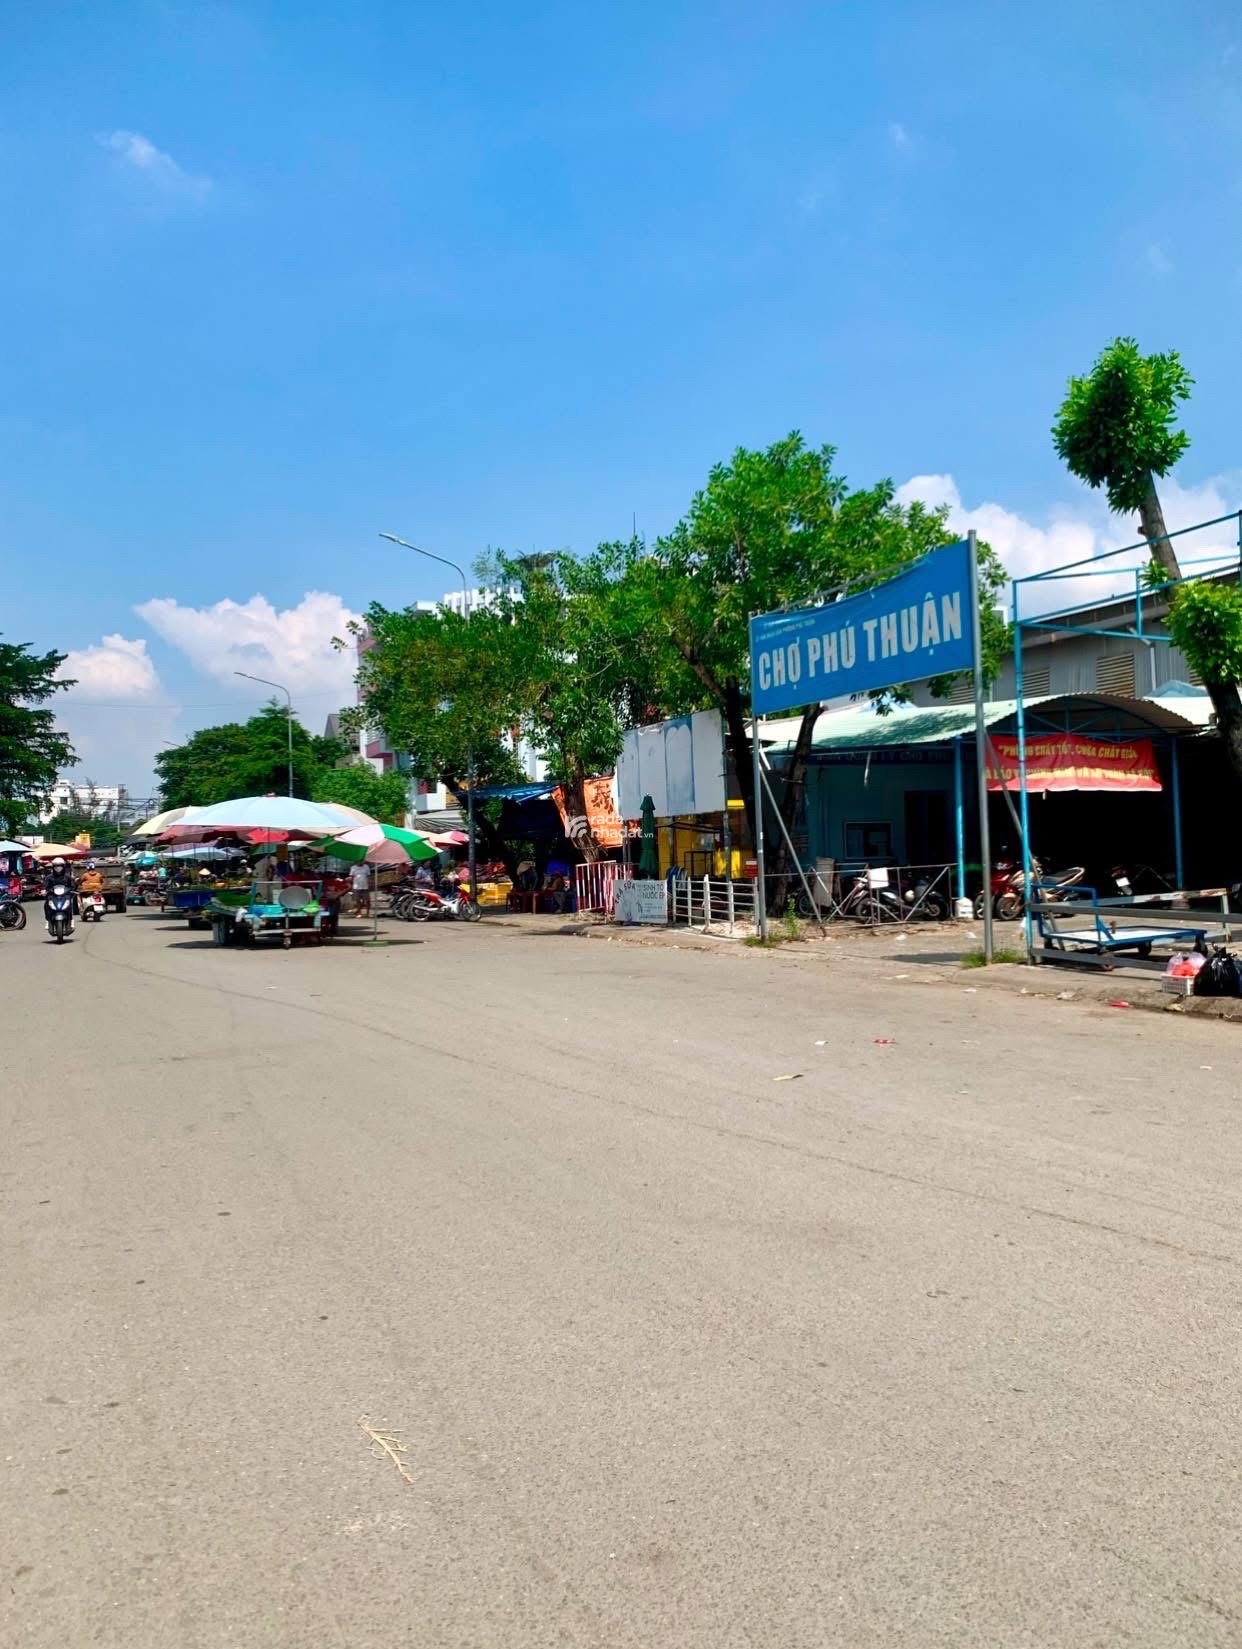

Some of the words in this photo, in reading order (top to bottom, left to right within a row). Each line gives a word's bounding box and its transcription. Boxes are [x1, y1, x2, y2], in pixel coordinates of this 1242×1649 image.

[759, 636, 801, 690] CHỢ
[807, 620, 857, 678] PHÚ
[863, 591, 962, 662] THUẬN
